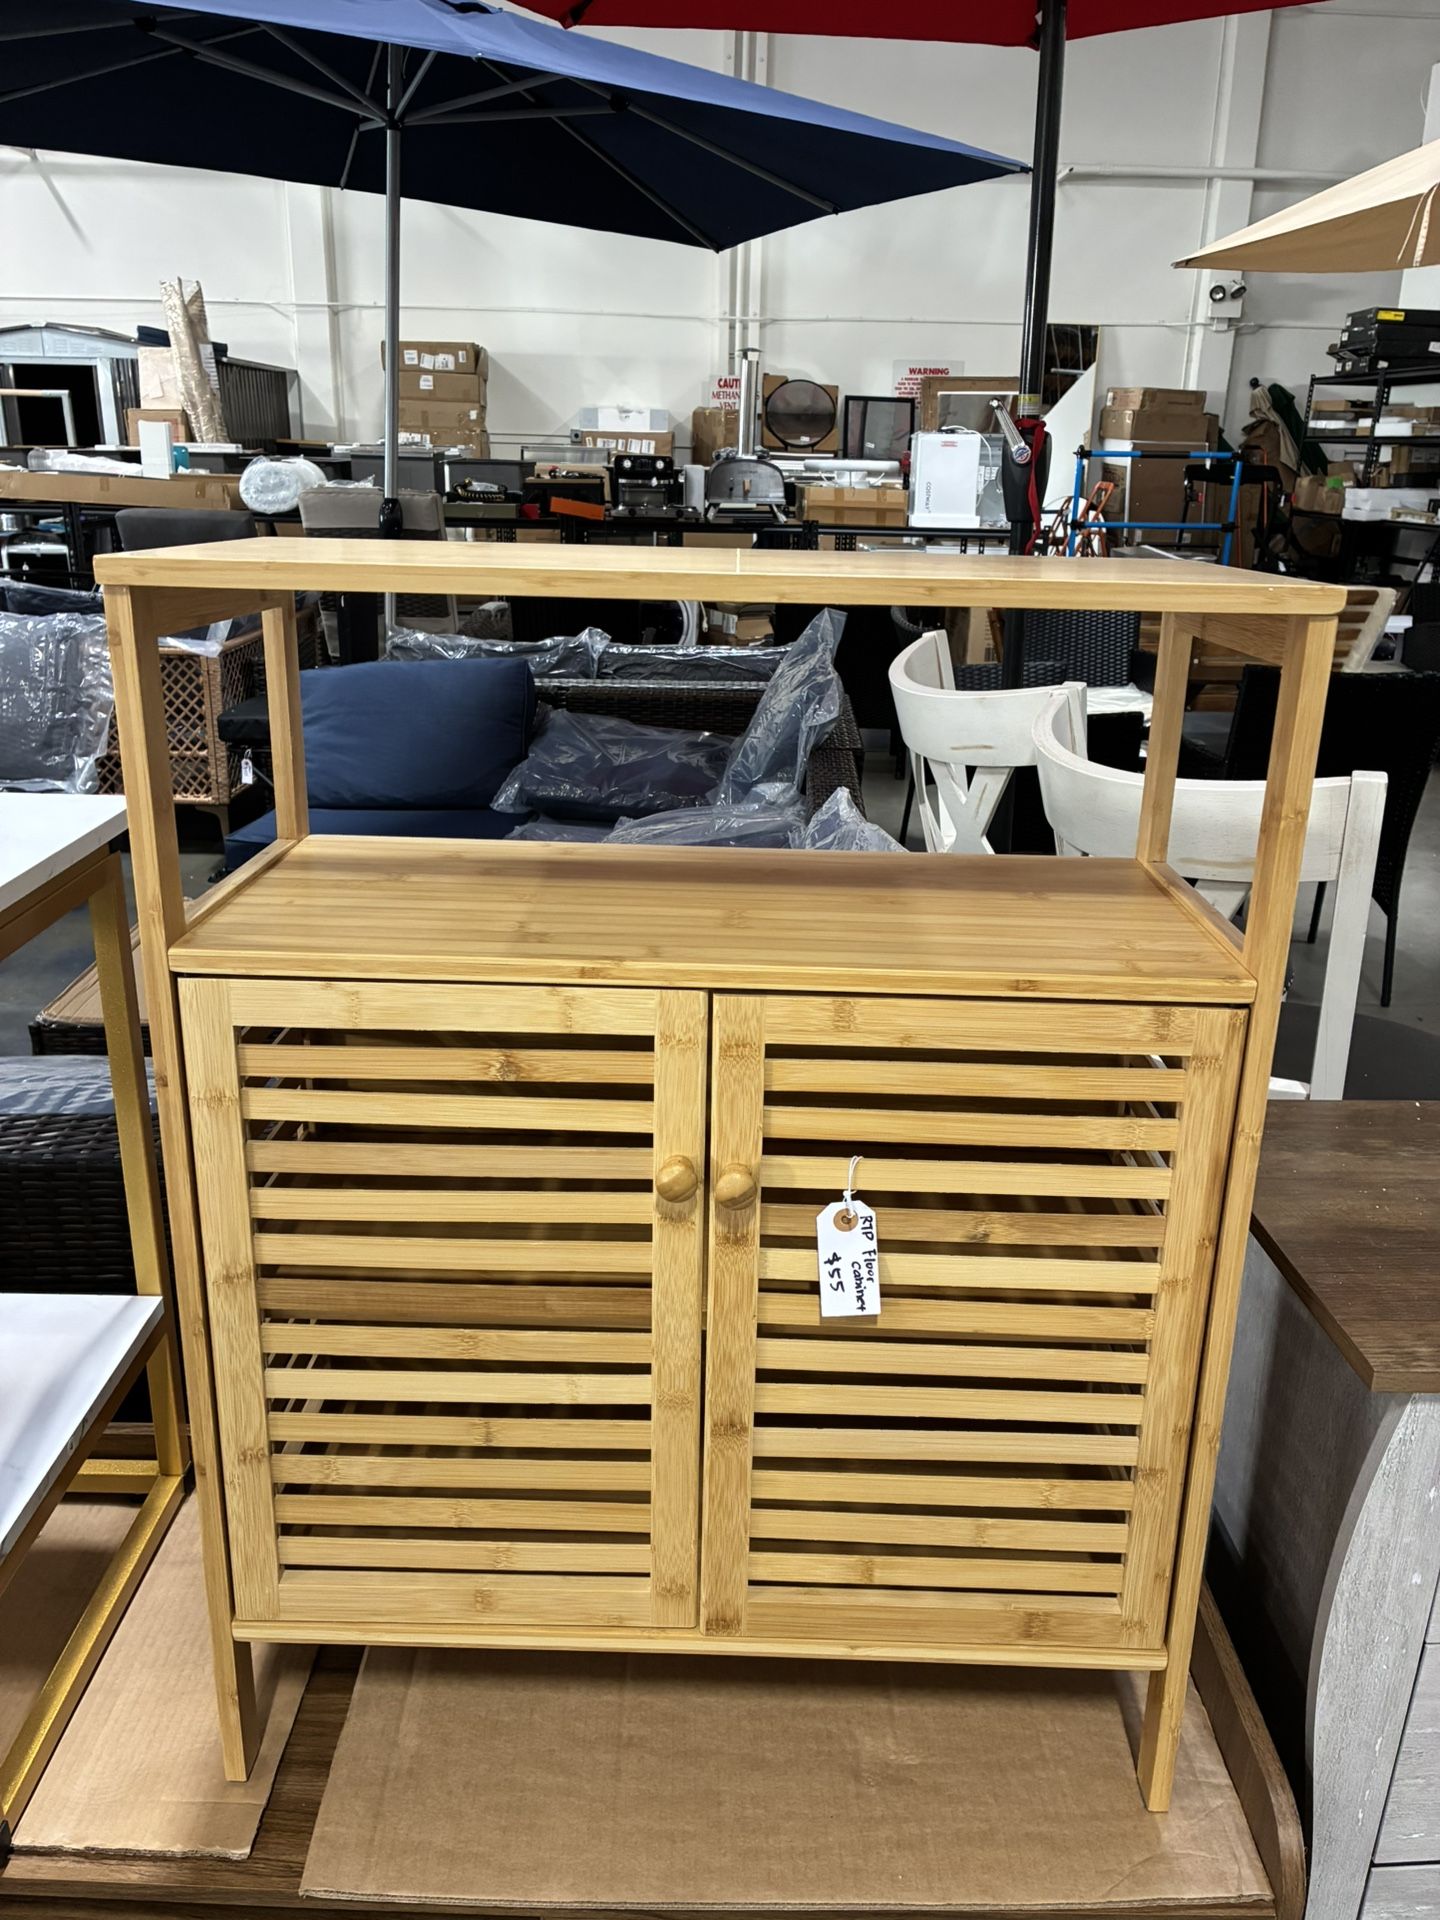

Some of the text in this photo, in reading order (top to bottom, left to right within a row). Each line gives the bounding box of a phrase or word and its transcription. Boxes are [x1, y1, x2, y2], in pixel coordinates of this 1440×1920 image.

[909, 367, 950, 375] WARNING
[717, 378, 741, 389] CAUT
[712, 391, 741, 400] METHAN
[860, 1215, 877, 1283] RTP Floor
[824, 1252, 845, 1293] $55
